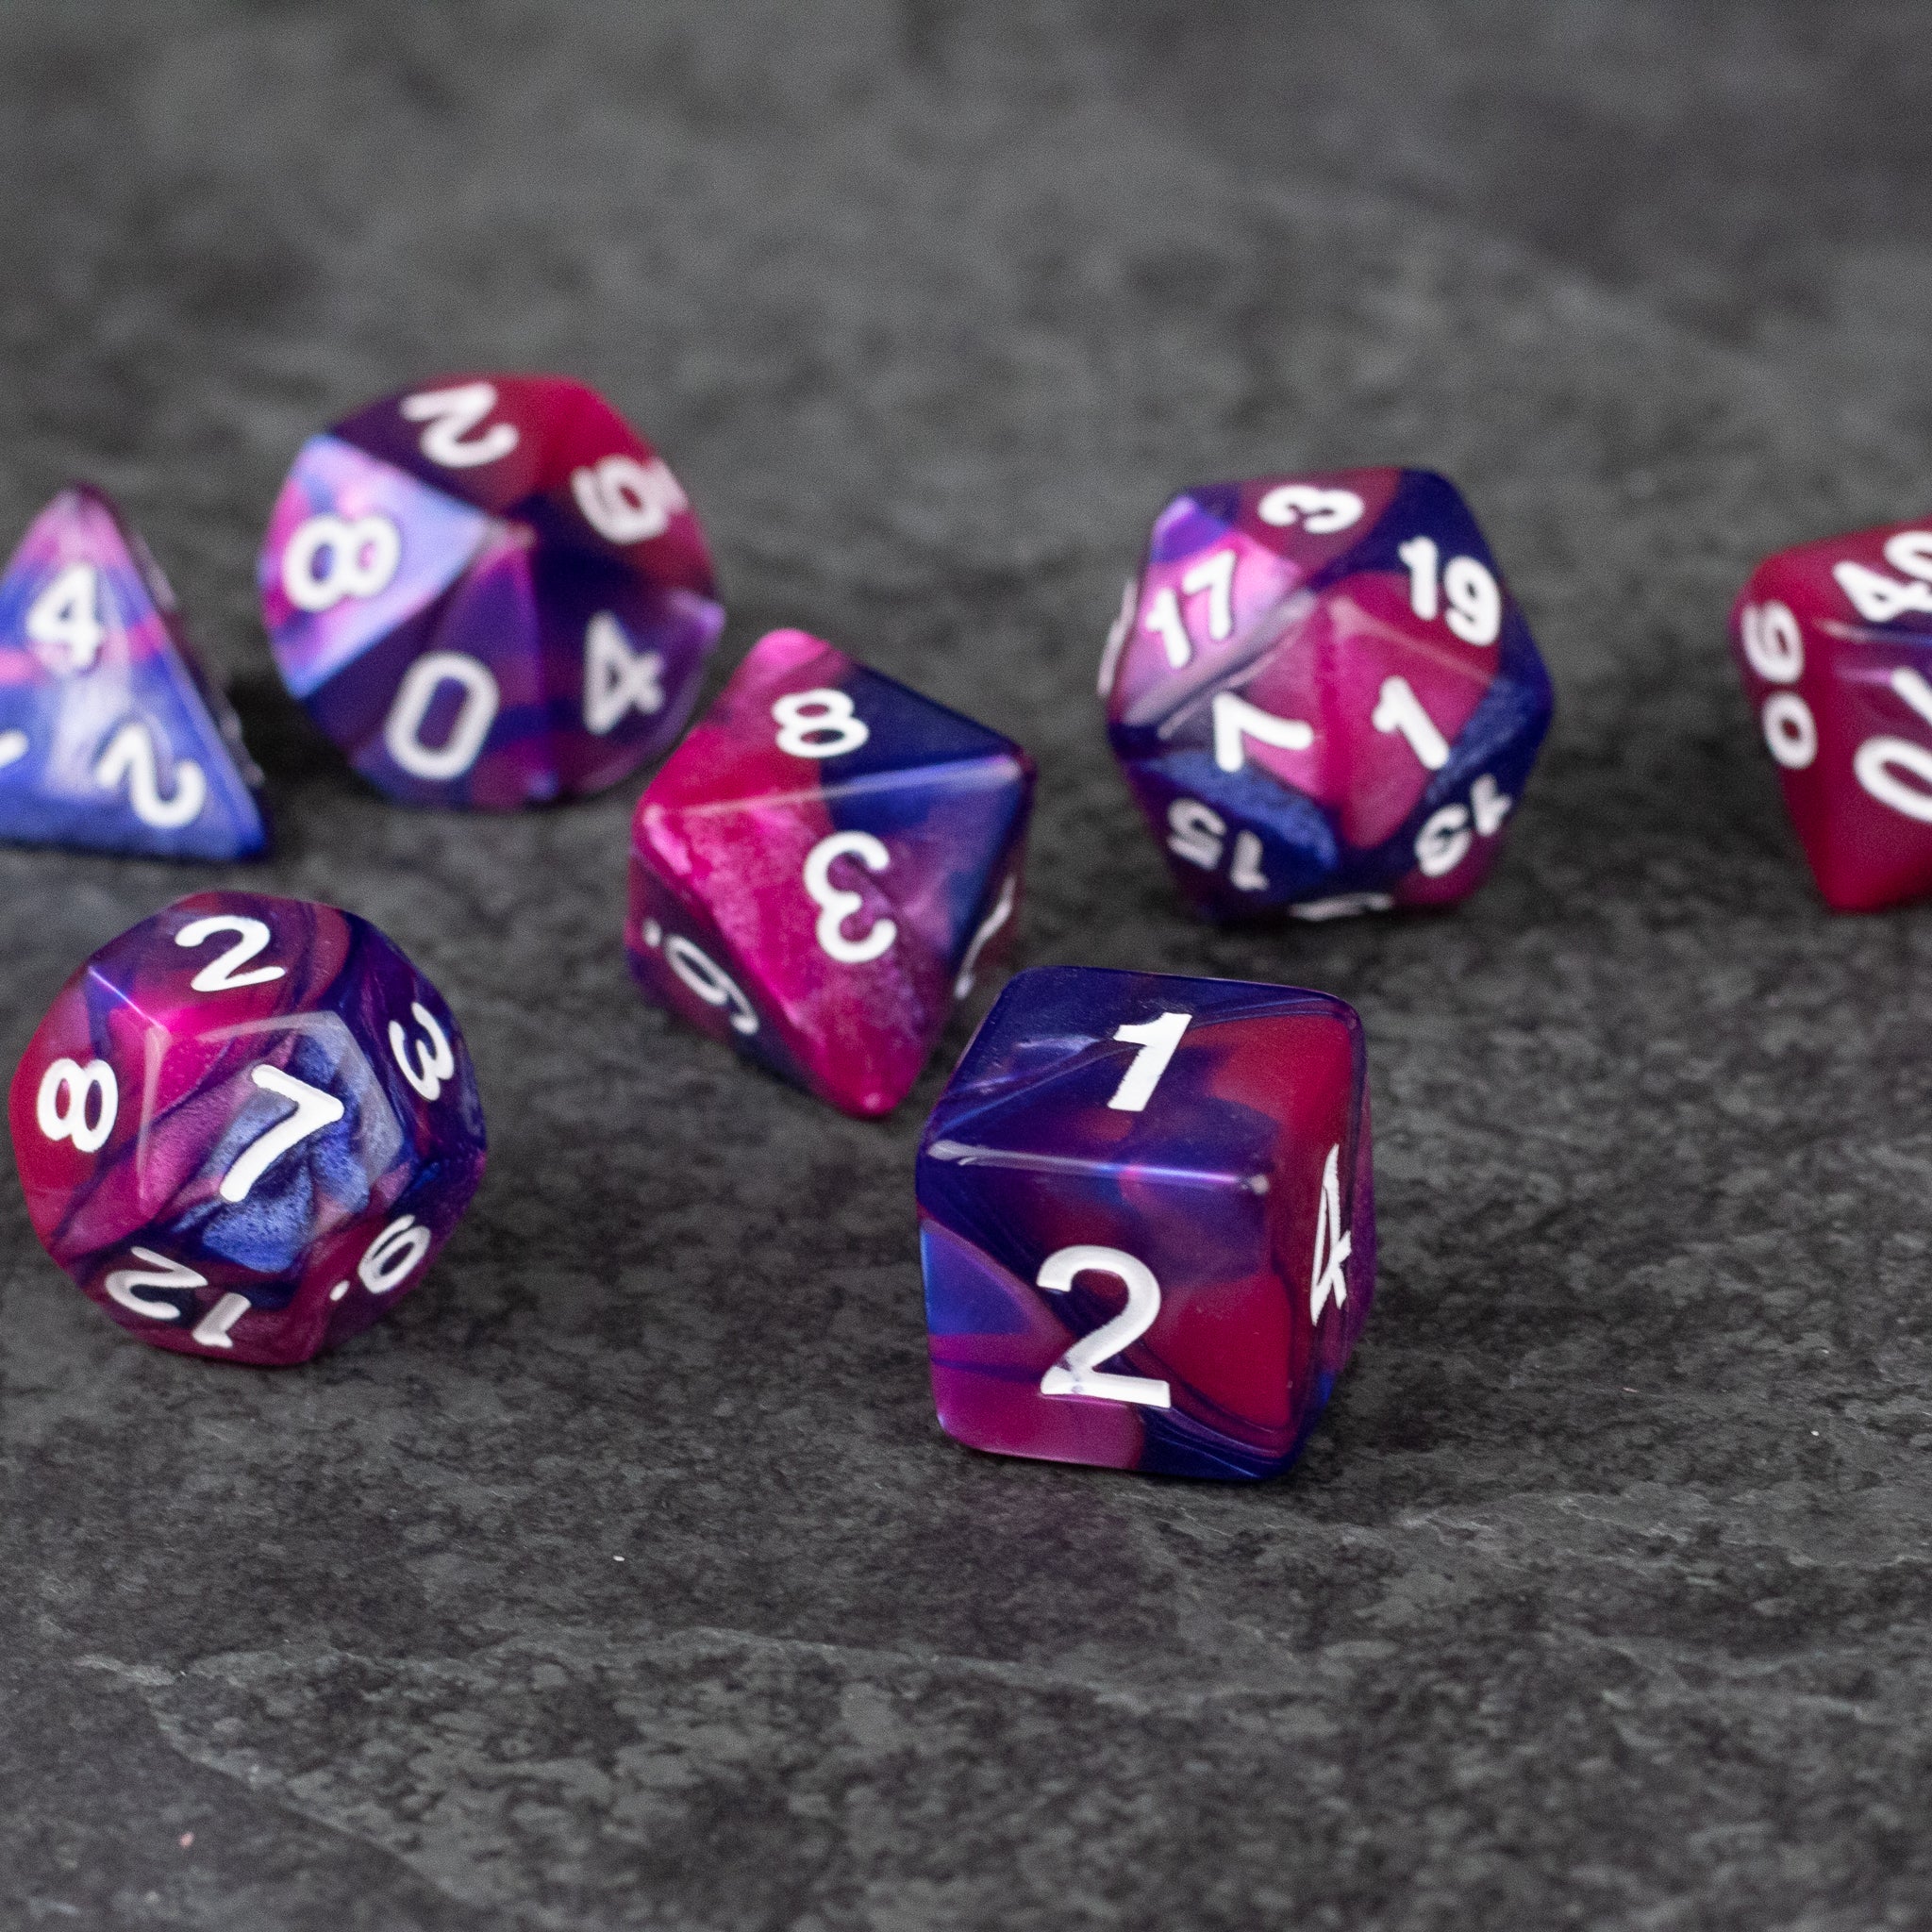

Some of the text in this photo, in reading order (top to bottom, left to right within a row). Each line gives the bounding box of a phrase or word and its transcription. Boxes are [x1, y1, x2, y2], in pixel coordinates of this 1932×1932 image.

[402, 381, 520, 469] 2
[1257, 483, 1366, 535] 3
[283, 514, 402, 611] 8
[1143, 548, 1238, 672] 17
[1398, 535, 1503, 648] 19
[25, 561, 104, 670] 4
[385, 651, 499, 781] 0
[583, 609, 664, 735] 4
[771, 688, 870, 759] 8
[1373, 675, 1451, 771] 1
[96, 721, 208, 830] 2
[1211, 690, 1315, 774] 7
[1166, 798, 1270, 891] 15
[1414, 774, 1511, 877] 13
[803, 830, 898, 964] 3
[174, 914, 287, 992] 2
[388, 1001, 456, 1102] 3
[1107, 1010, 1193, 1113] 1
[36, 1057, 120, 1154] 8
[218, 1062, 346, 1204] 7
[1308, 1142, 1353, 1327] 4
[104, 1245, 252, 1350] 12
[1036, 1244, 1172, 1409] 2
